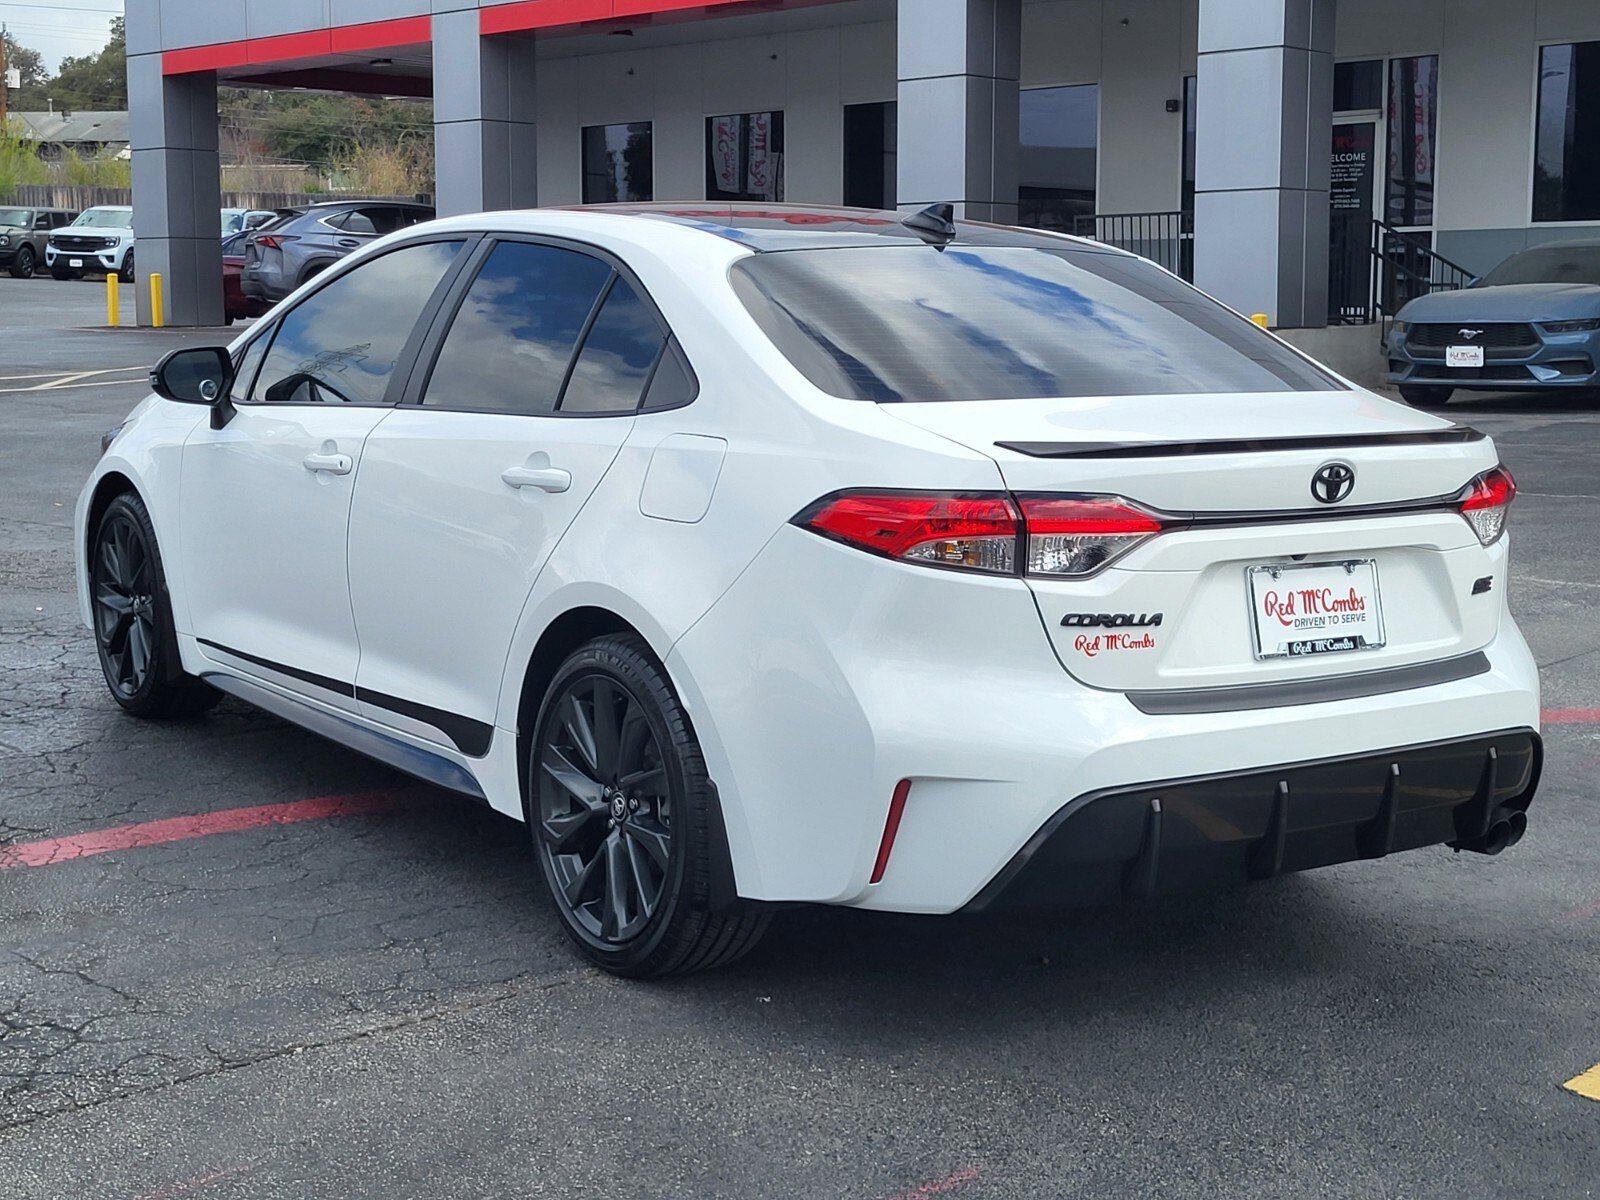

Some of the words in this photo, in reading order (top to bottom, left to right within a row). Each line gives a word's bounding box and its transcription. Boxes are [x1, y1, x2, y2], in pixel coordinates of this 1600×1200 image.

[1331, 153, 1367, 163] ELCOME
[1264, 590, 1296, 626] Red
[1296, 587, 1365, 614] McCombs
[1060, 613, 1163, 628] COROLLA
[1294, 617, 1326, 628] DRIVEN
[1328, 615, 1339, 625] TO
[1341, 613, 1366, 623] SERVE
[1075, 635, 1100, 657] Red
[1102, 633, 1155, 650] McCombs
[1293, 641, 1312, 655] Red
[1313, 638, 1354, 653] McCombs
